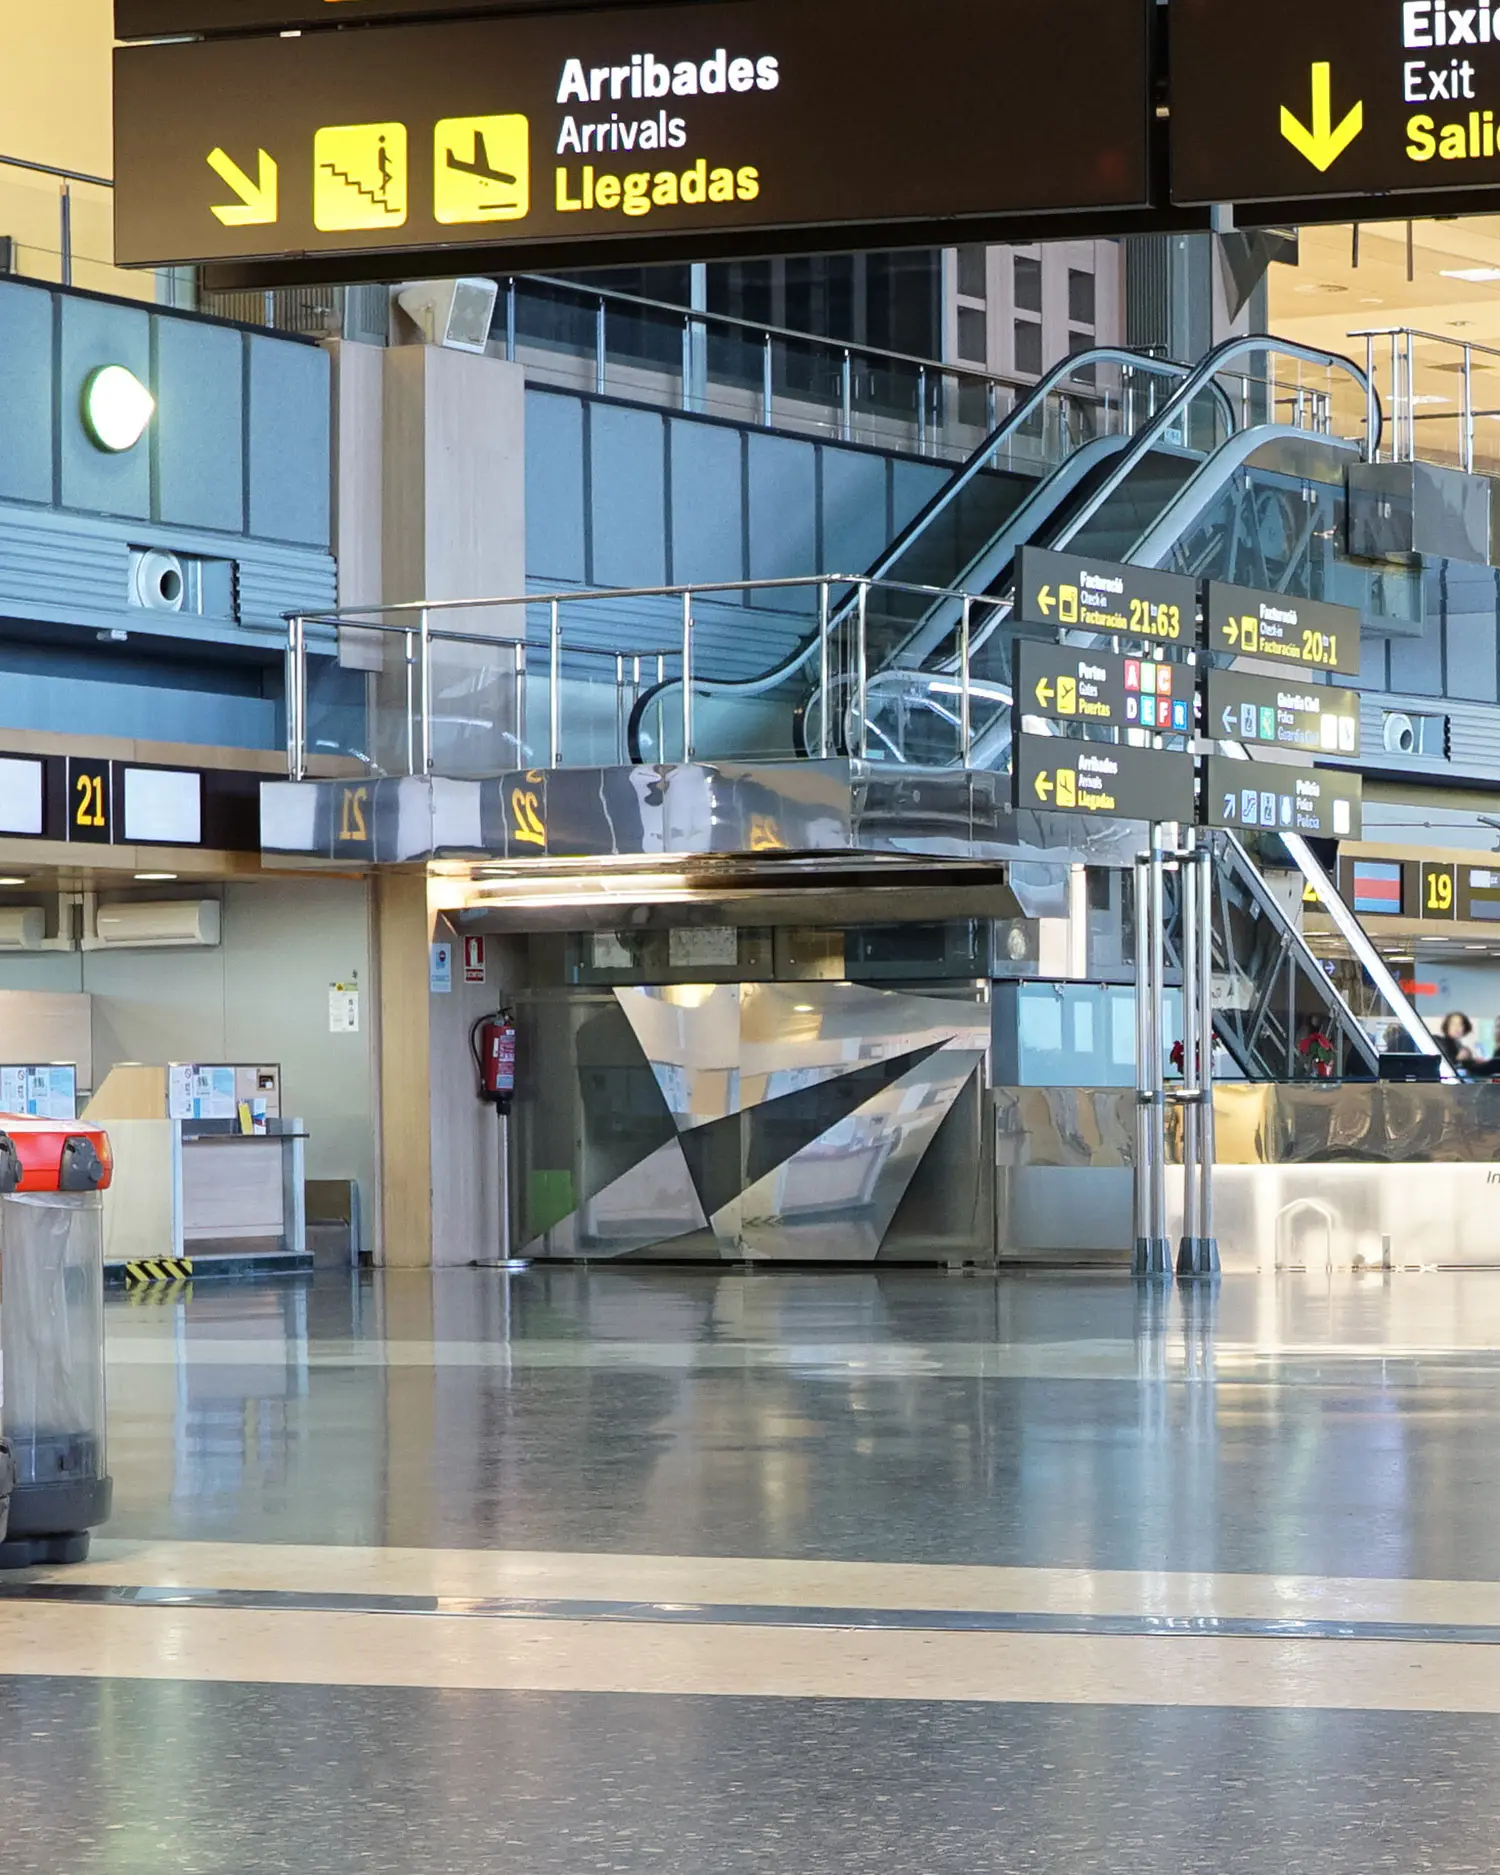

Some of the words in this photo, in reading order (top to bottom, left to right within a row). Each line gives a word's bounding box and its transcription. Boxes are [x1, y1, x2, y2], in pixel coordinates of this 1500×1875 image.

[556, 48, 779, 103] Arribades
[1404, 59, 1475, 102] Exit
[556, 110, 687, 154] Arrivals
[556, 158, 760, 216] Llegadas
[76, 775, 105, 826] 21
[1427, 873, 1452, 909] 19
